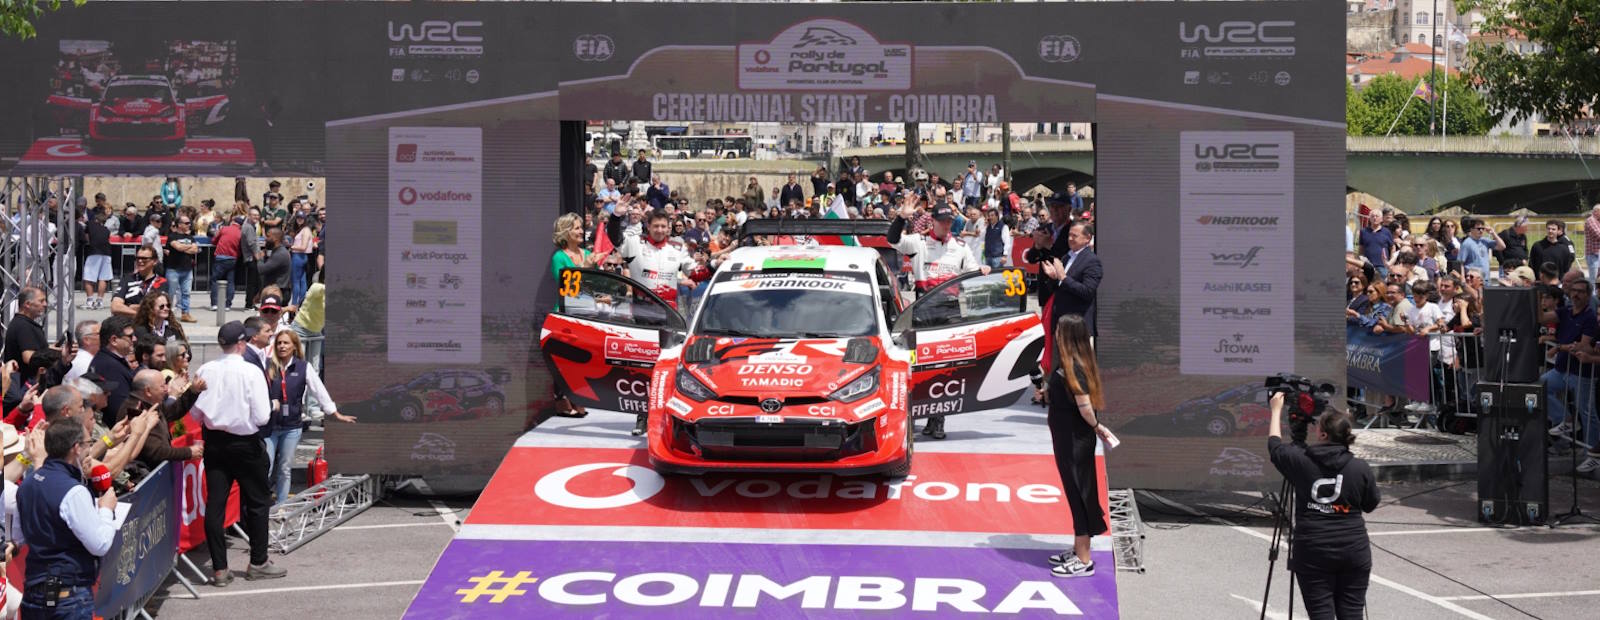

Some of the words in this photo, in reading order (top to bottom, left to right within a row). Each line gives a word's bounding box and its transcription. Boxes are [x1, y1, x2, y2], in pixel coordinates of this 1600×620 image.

[388, 21, 483, 41] WRC
[1179, 21, 1295, 42] WRC
[576, 39, 611, 56] FIA
[790, 50, 824, 61] rally
[827, 50, 846, 59] de
[1039, 40, 1078, 56] FIA
[788, 60, 888, 76] Portugal
[652, 92, 795, 121] CEREMONIAL
[799, 93, 868, 121] START
[888, 93, 998, 122] COIMBRA
[1195, 144, 1279, 159] WRC
[420, 190, 473, 201] vodafone
[429, 251, 469, 265] Portugal
[559, 269, 582, 298] 33
[1002, 269, 1026, 297] 33
[737, 364, 813, 375] DENSO
[741, 378, 804, 387] TAMADIC
[410, 453, 456, 463] Portugal
[1209, 467, 1265, 477] Portugal
[687, 472, 1062, 504] vodafone
[456, 569, 1084, 615] #COIMBRA
